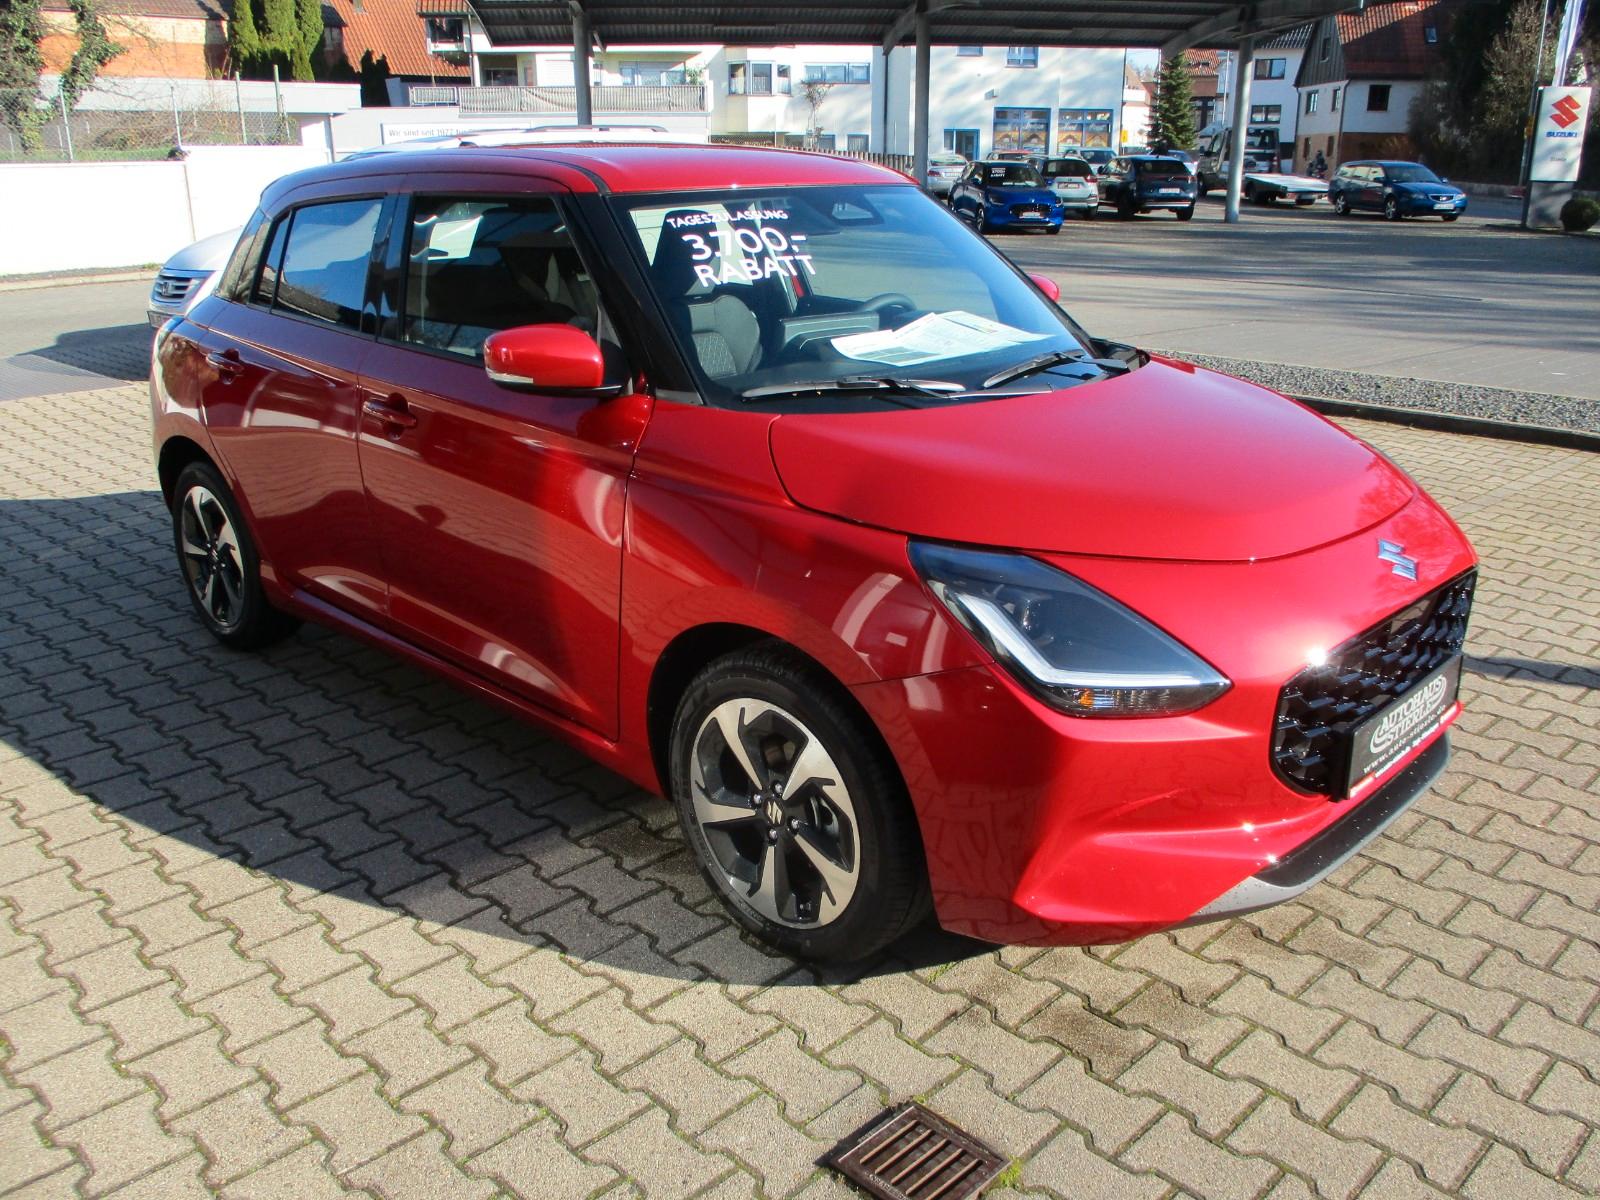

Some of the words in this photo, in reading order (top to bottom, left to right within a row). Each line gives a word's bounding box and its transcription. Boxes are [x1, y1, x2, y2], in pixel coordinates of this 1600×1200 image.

[666, 209, 789, 229] TAGESZULASSUNG
[693, 255, 816, 287] RABATT
[1379, 675, 1443, 736] AUTOHAUS
[1385, 700, 1438, 742] STIERLE
